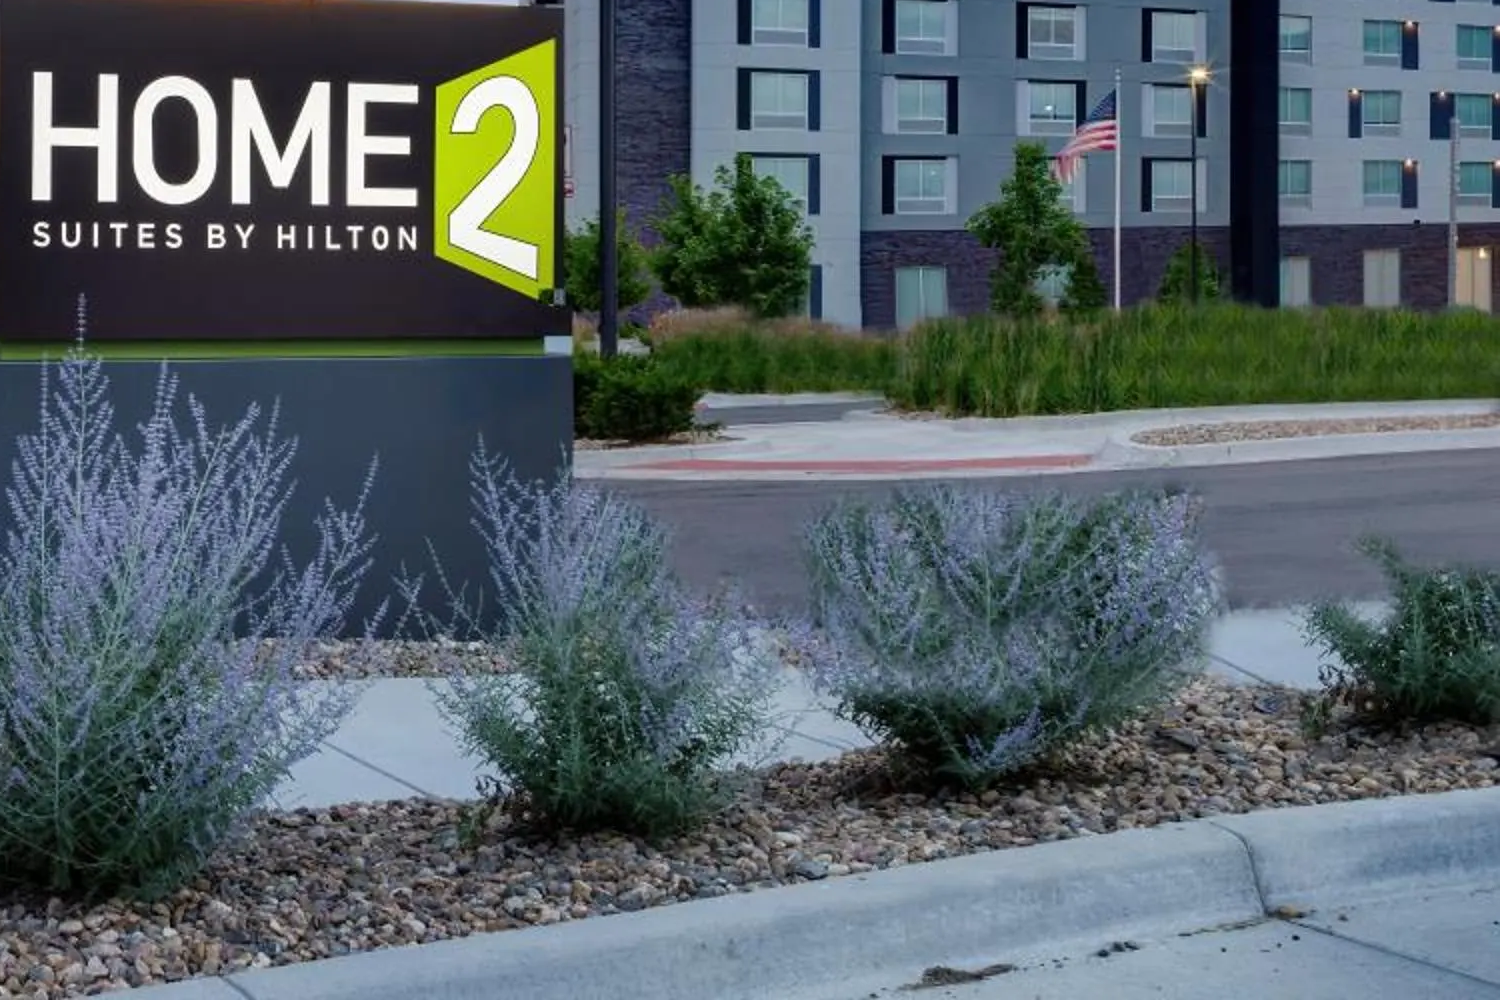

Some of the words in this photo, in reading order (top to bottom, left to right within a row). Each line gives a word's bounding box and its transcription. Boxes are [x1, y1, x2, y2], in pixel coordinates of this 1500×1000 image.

[32, 221, 183, 249] SUITES
[207, 223, 255, 249] BY
[277, 224, 417, 251] HILTON
